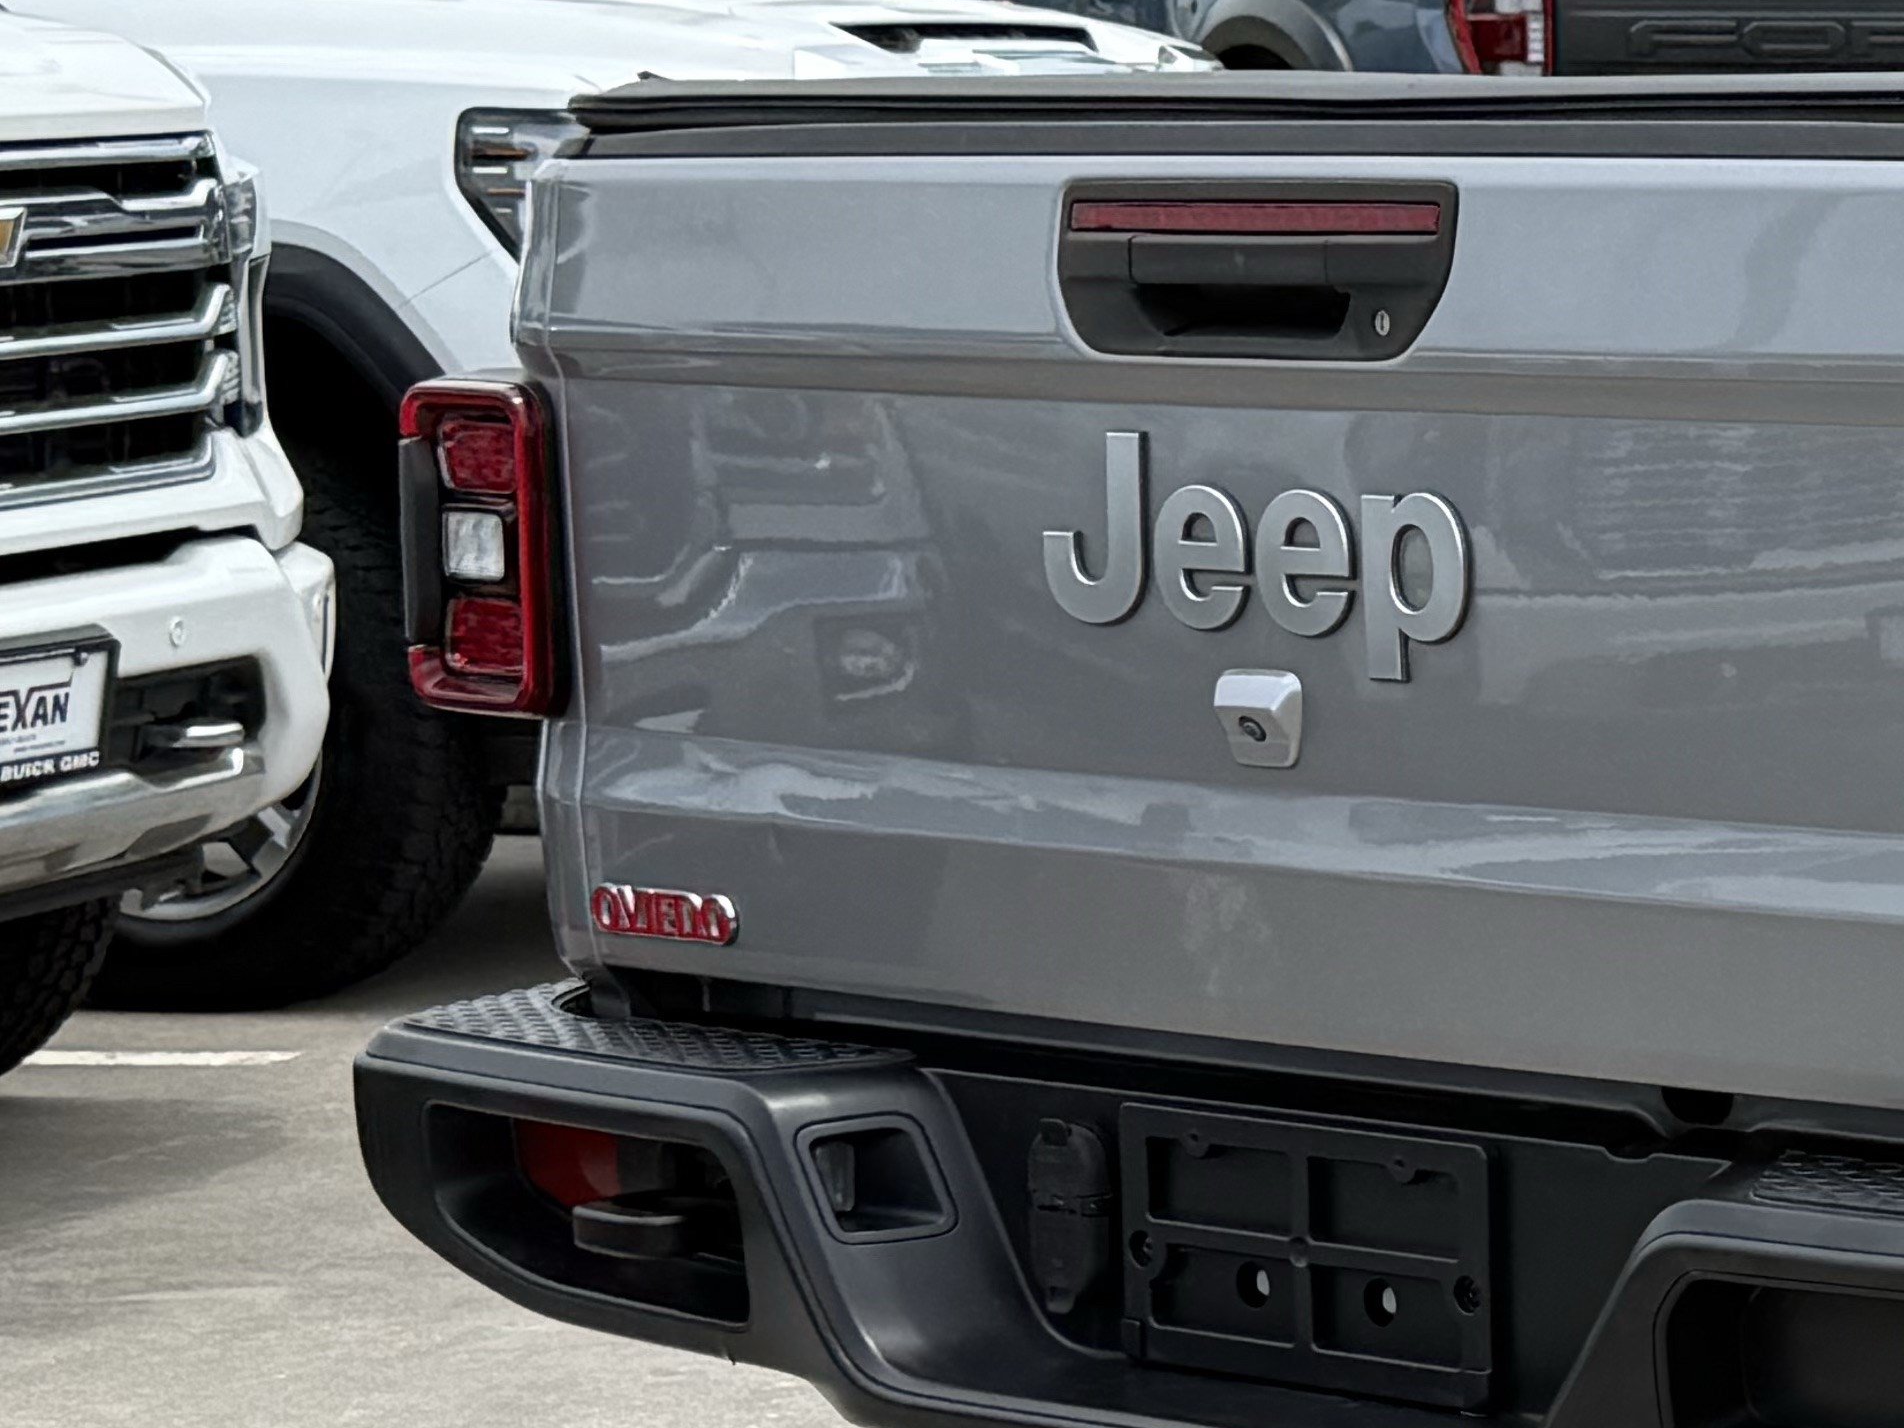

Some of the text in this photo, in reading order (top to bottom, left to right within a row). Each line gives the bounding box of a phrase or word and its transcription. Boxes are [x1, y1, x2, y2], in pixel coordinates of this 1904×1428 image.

[1042, 430, 1471, 682] Jeep
[0, 750, 100, 784] BUICK GMC
